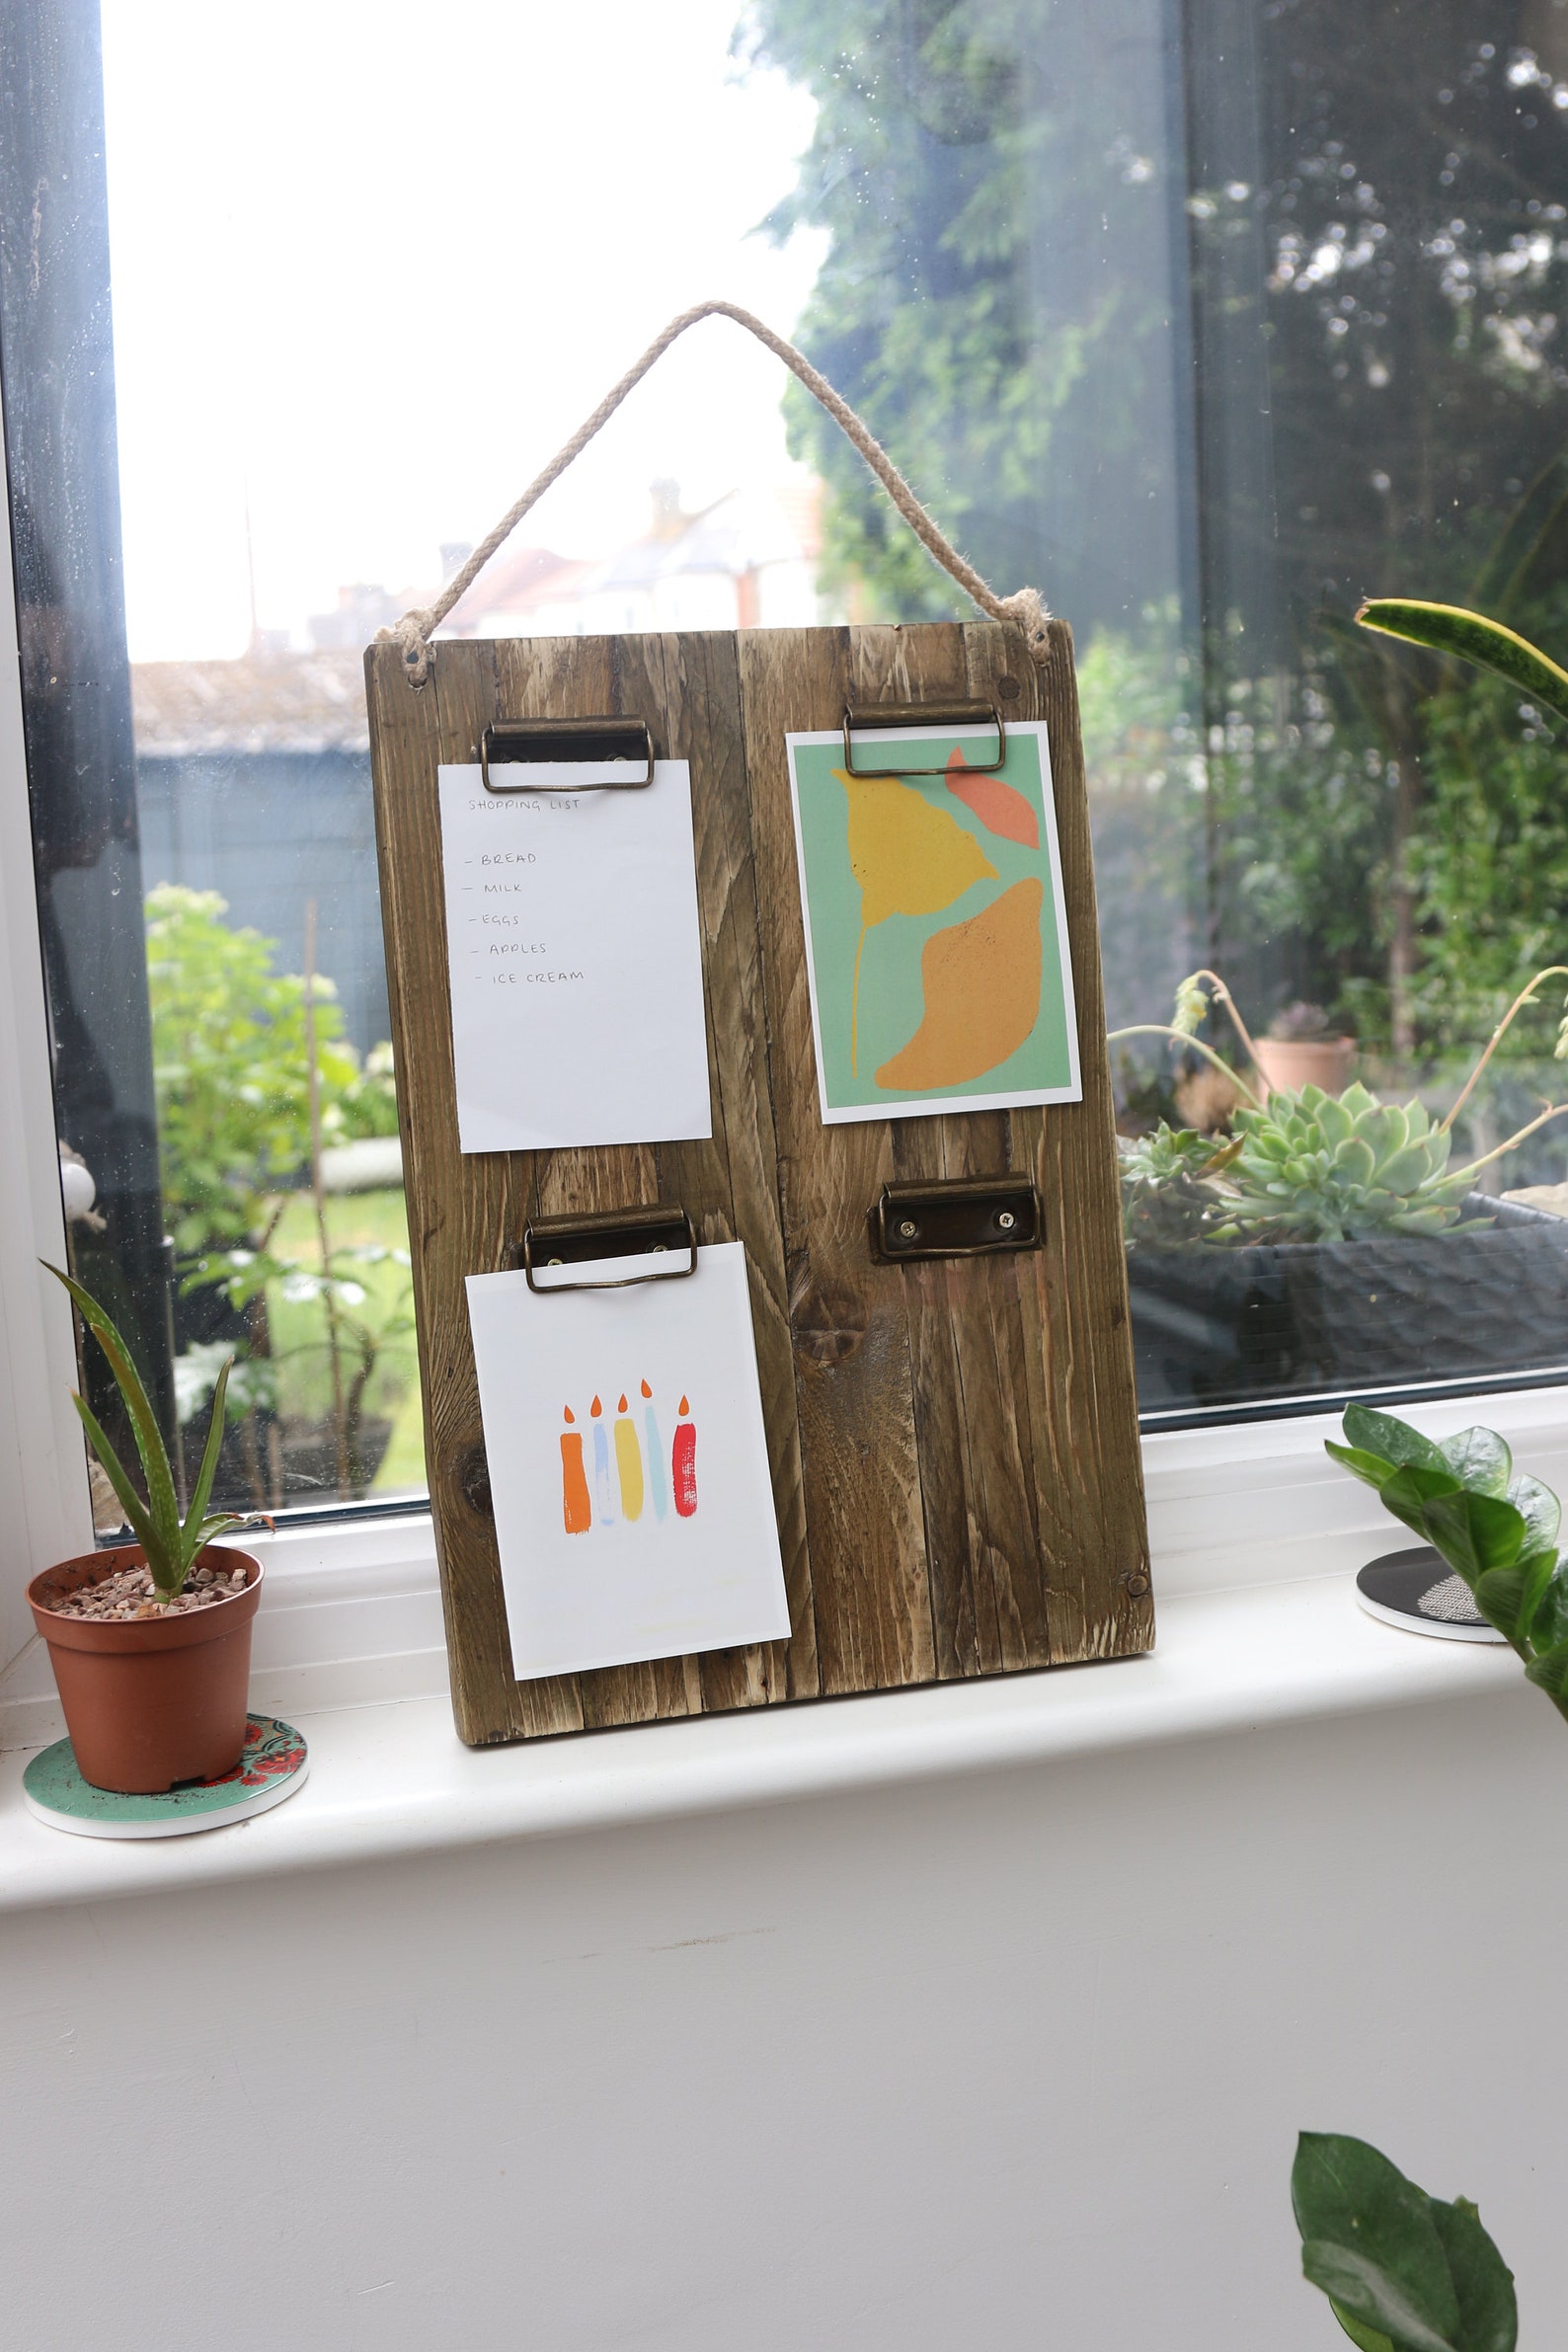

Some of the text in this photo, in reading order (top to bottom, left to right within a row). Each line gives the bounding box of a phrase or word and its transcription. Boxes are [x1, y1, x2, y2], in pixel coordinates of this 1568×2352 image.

[468, 799, 581, 812] SHOPPING LIST
[481, 852, 537, 866] BREAD
[484, 883, 521, 893] MILK
[482, 913, 519, 926] EGGS
[489, 942, 546, 955] APPLES
[493, 971, 585, 983] ICE CREAM
